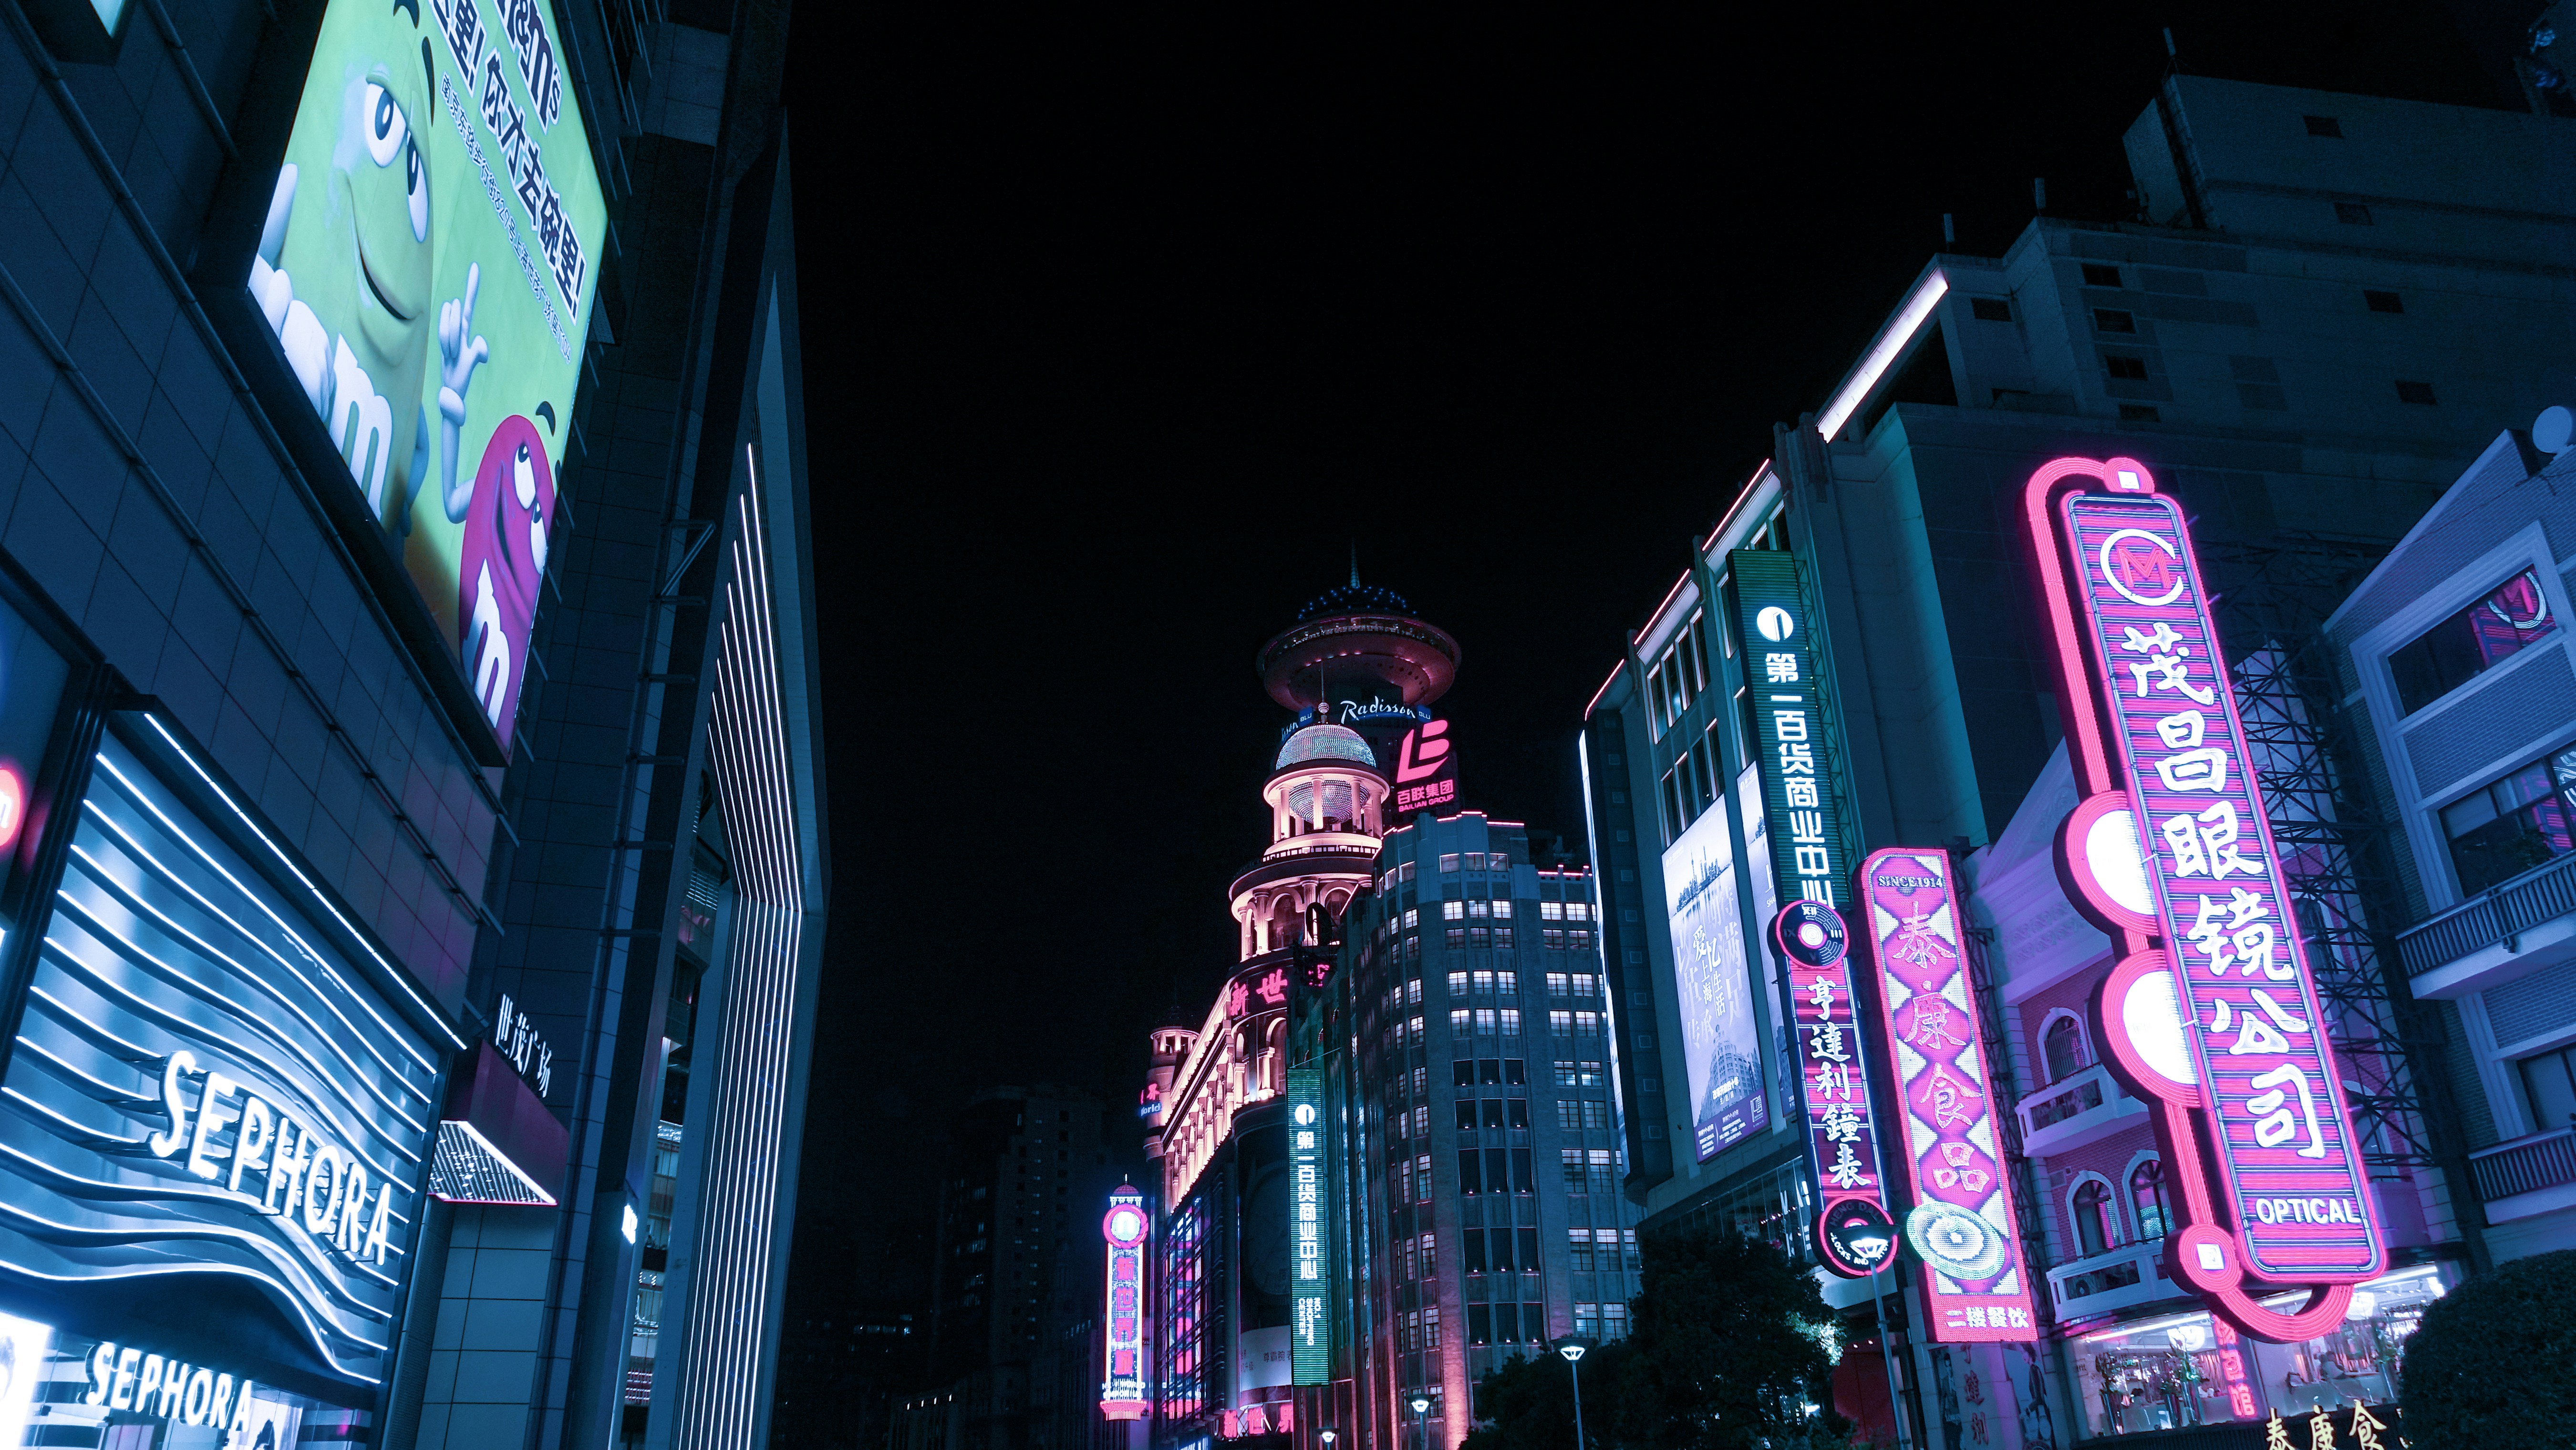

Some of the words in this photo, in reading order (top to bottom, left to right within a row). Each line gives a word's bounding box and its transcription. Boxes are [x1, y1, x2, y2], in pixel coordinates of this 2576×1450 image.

[1300, 713, 1312, 722] BLU
[1340, 695, 1416, 724] Radisson
[1419, 711, 1430, 720] BLU
[1397, 779, 1453, 805] 百联集团
[1398, 800, 1427, 812] BAILIAN
[1429, 794, 1454, 805] GROUP
[1765, 652, 1836, 910] 第一百货商业中心
[2121, 622, 2326, 1160] 茂昌眼镜公司
[496, 993, 552, 1098] 世茂广场
[1807, 975, 1873, 1190] 亨達利鐘表
[151, 1050, 391, 1265] SEPHORA
[1297, 1130, 1318, 1279] 第一百货商业中心
[2255, 1198, 2361, 1226] OPTICAL
[1115, 1256, 1134, 1376] 新世界城
[1306, 1298, 1314, 1346] SHOPPING
[1946, 1306, 2029, 1328] 二楼餐饮
[86, 1342, 253, 1432] SEPHORA
[2266, 1399, 2413, 1450] 泰康食
